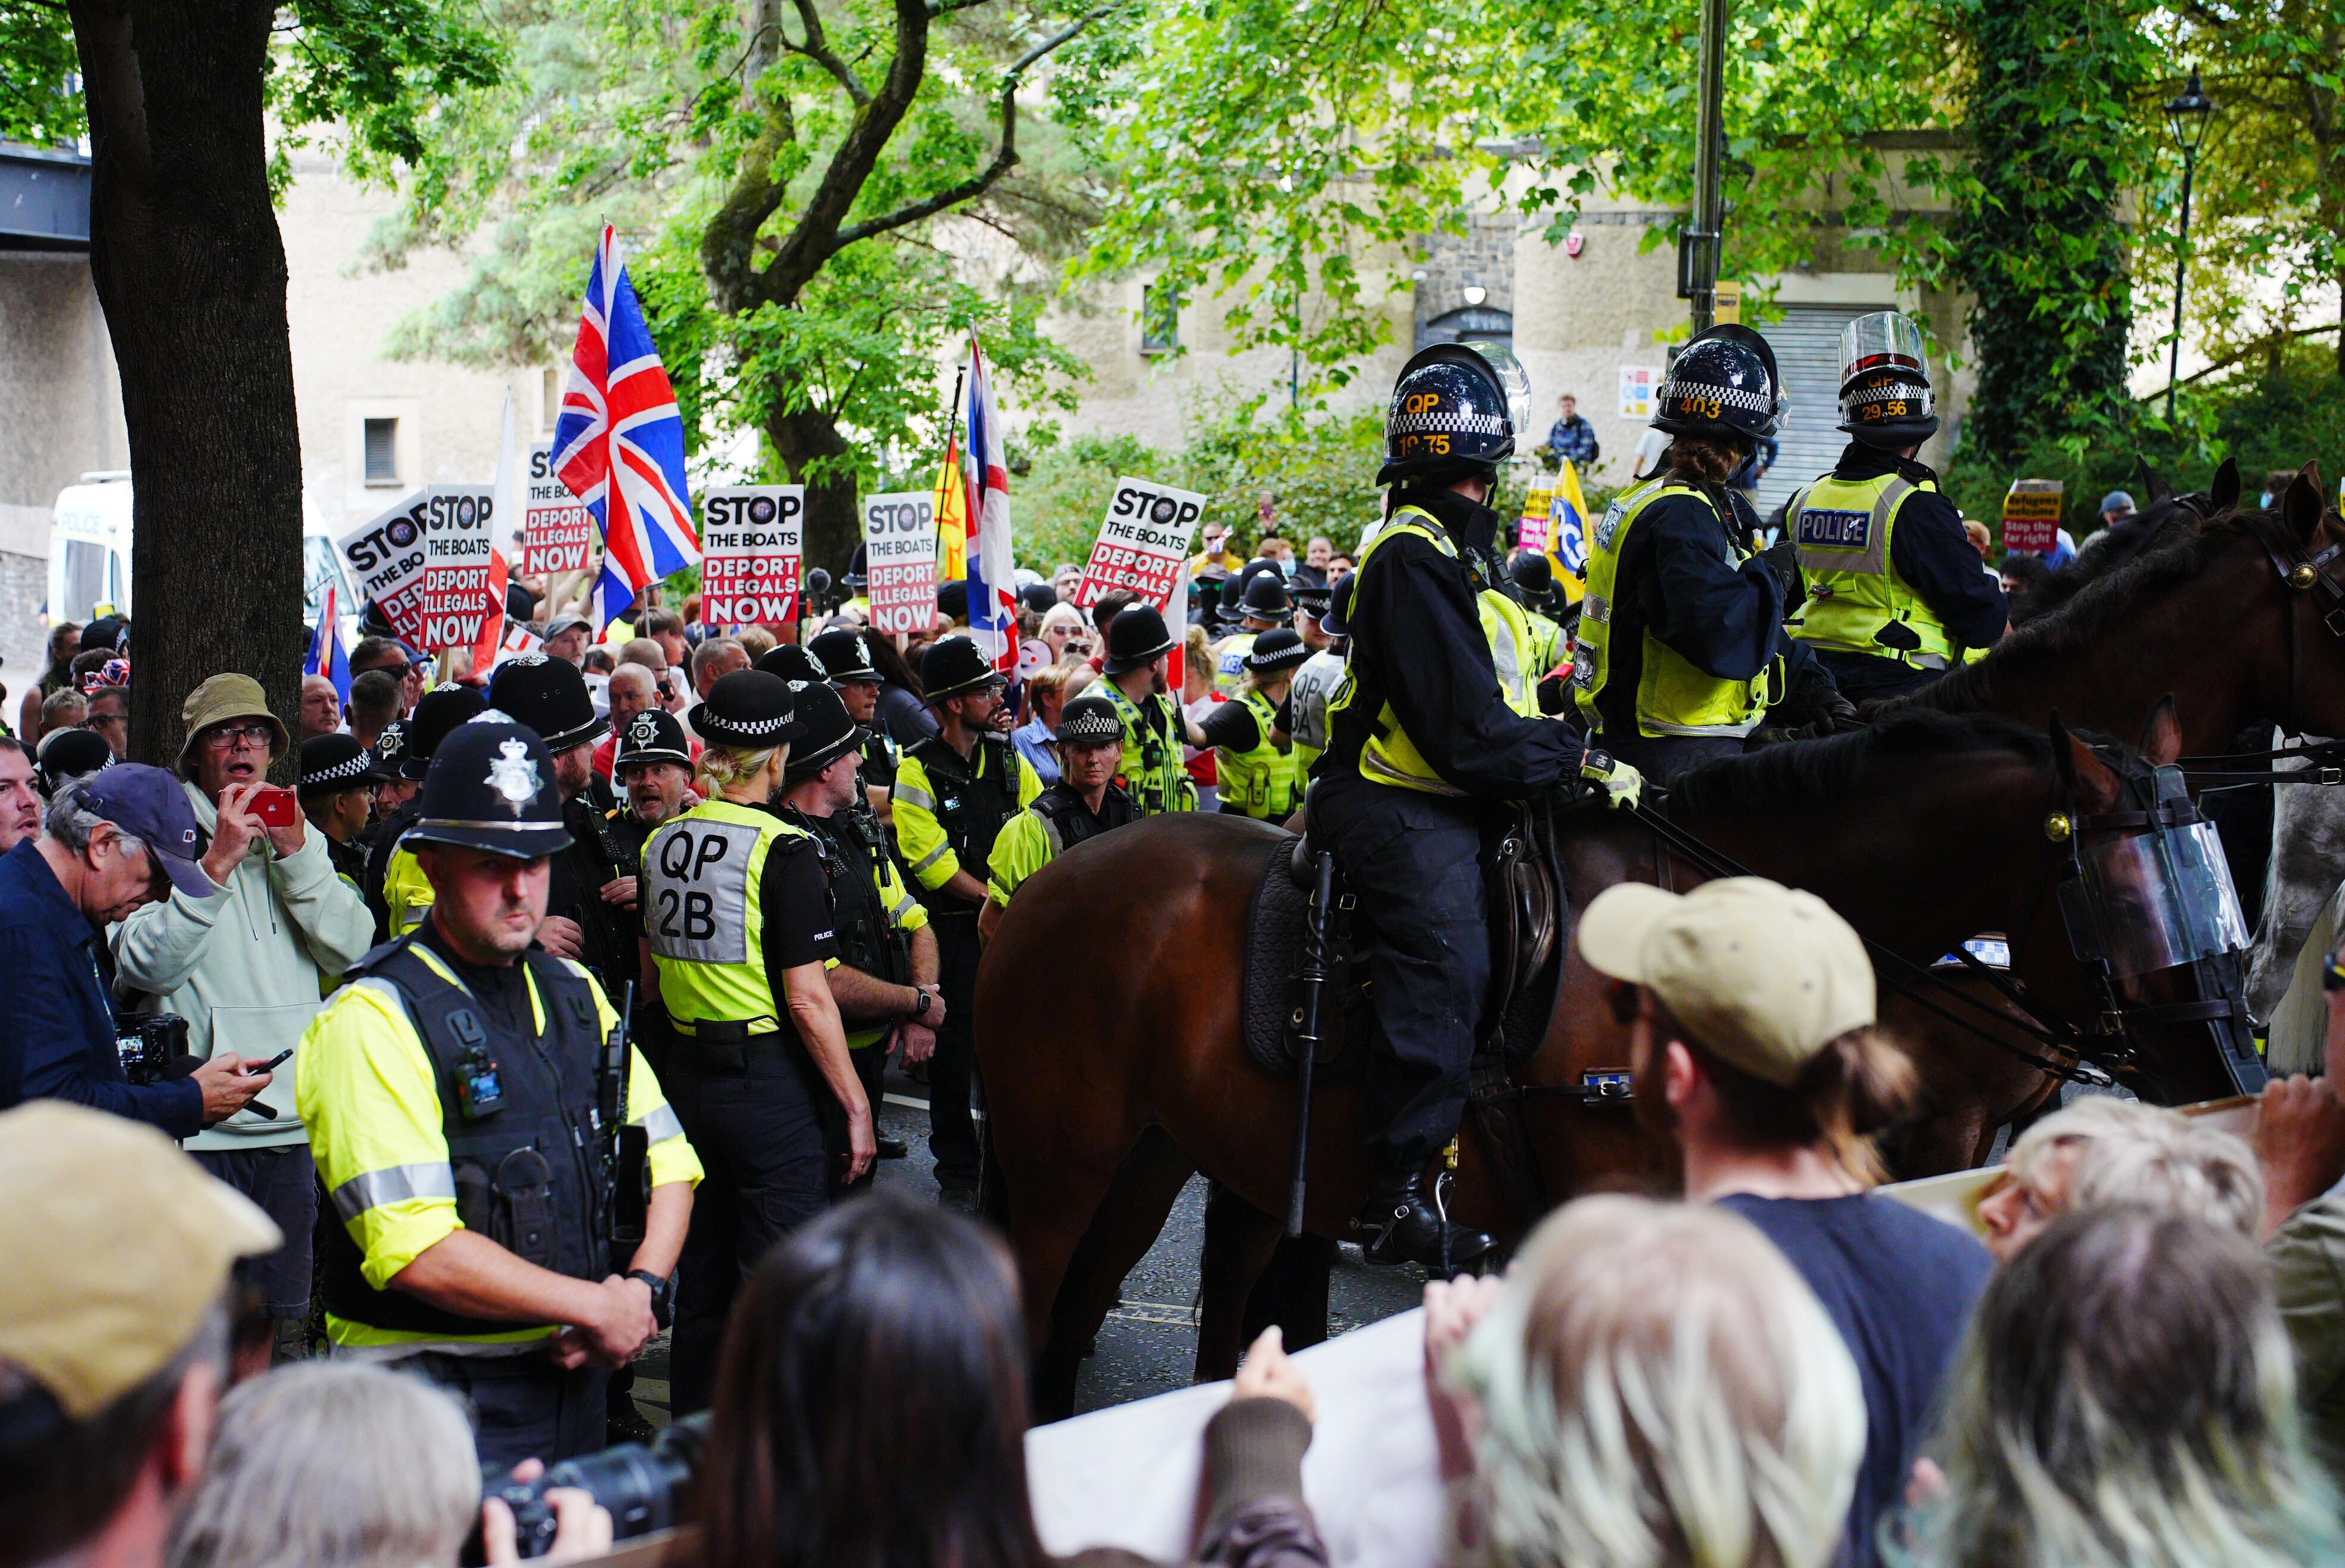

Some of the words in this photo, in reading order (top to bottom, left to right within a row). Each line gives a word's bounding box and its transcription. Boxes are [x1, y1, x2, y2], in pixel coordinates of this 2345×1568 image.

[1406, 393, 1439, 413] QP
[1862, 404, 1881, 420] 29
[1887, 401, 1907, 416] 56
[1423, 435, 1450, 455] 75
[531, 486, 552, 499] THE
[430, 496, 493, 530] STOP
[528, 508, 589, 529] DEPORT
[707, 496, 800, 525] STOP
[869, 502, 932, 534] STOP
[1114, 488, 1199, 528] STOP
[62, 512, 101, 534] POLICE
[1800, 514, 1865, 541] POLICE
[2005, 520, 2030, 533] Stop
[2033, 520, 2051, 532] the
[525, 527, 589, 547] ILLEGALS
[708, 534, 738, 547] THE
[742, 532, 797, 546] BOATS
[1108, 521, 1135, 539] THE
[1136, 528, 1186, 550] BOATS
[429, 539, 449, 556] THE
[452, 539, 489, 555] BOATS
[528, 543, 586, 574] NOW
[871, 542, 892, 556] THE
[895, 539, 932, 554] BOATS
[706, 557, 798, 578] DEPORT
[1094, 545, 1178, 578] DEPORT
[367, 566, 402, 591] THE
[426, 569, 489, 592] DEPORT
[704, 577, 797, 596] ILLEGALS
[872, 564, 935, 587] DEPORT
[1086, 563, 1171, 595] ILLEGALS
[423, 592, 487, 614] ILLEGALS
[870, 584, 935, 606] ILLEGALS
[710, 595, 792, 624] NOW
[876, 602, 934, 633] NOW
[425, 614, 483, 647] NOW
[1295, 674, 1320, 704] QP
[660, 830, 728, 883] QP
[658, 888, 715, 941] 2B
[814, 930, 833, 941] POLICE
